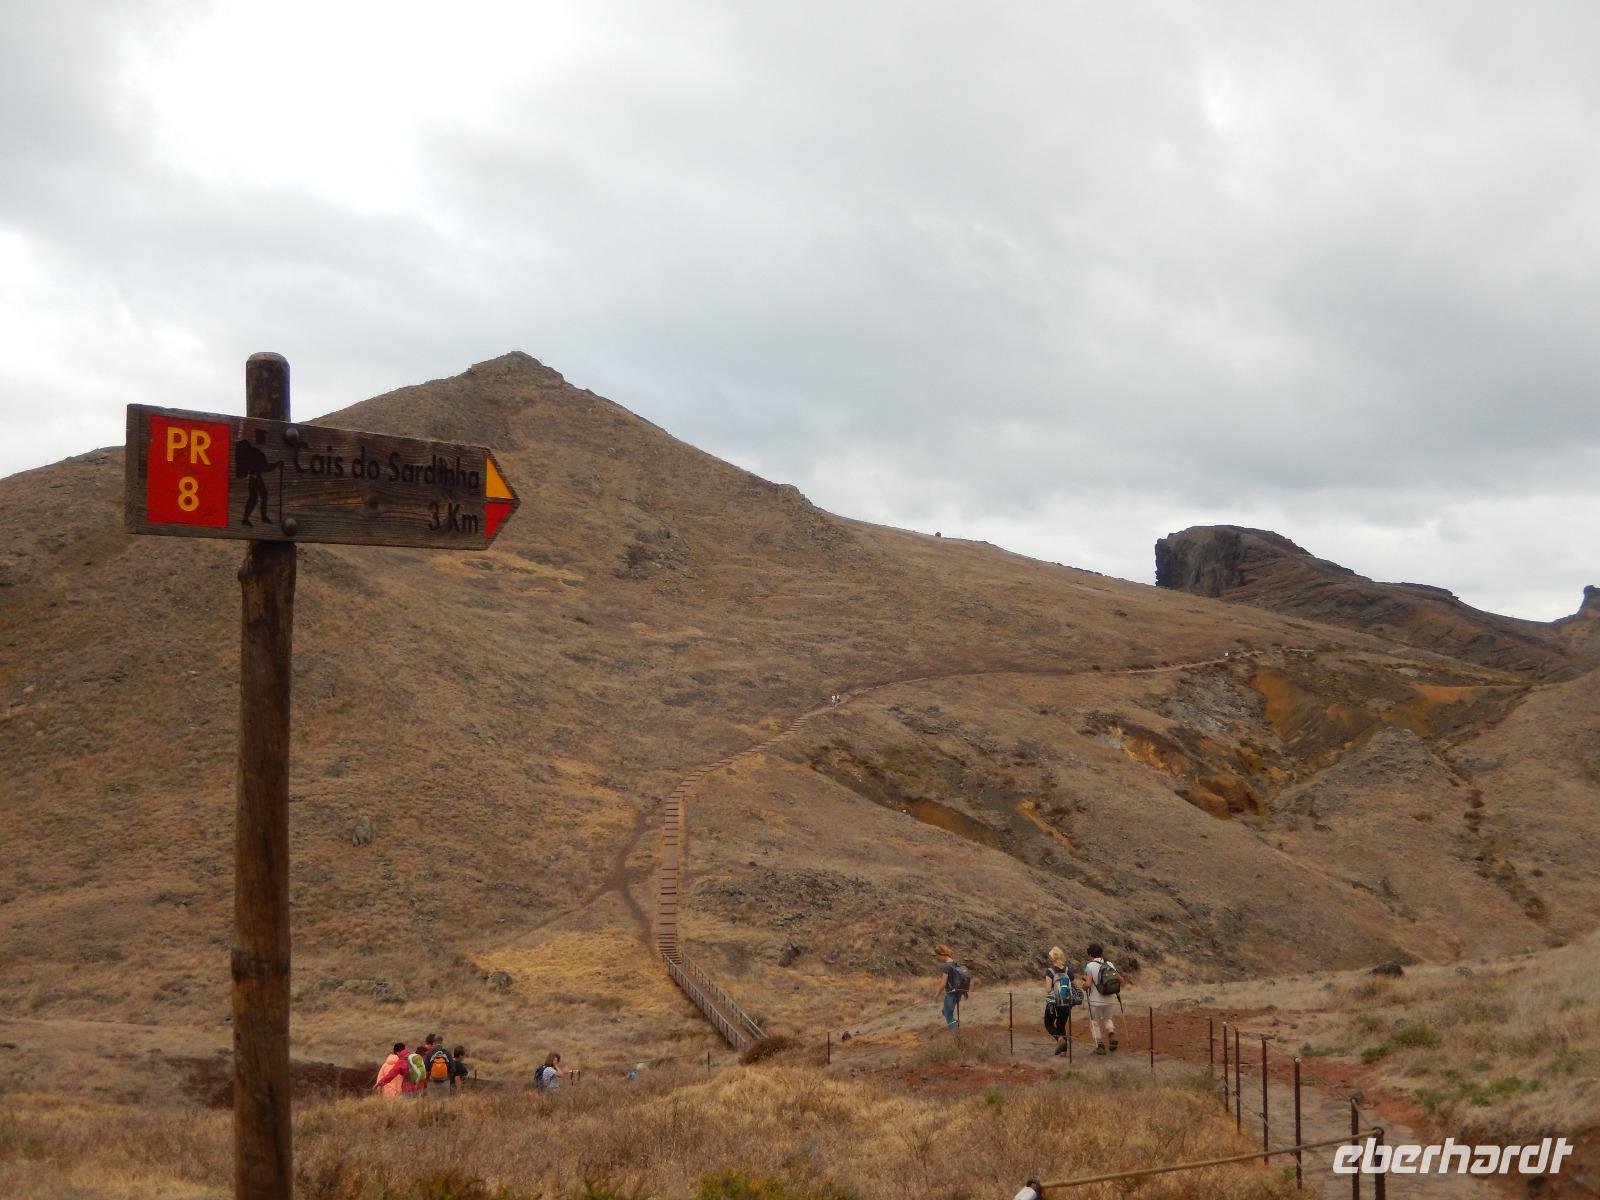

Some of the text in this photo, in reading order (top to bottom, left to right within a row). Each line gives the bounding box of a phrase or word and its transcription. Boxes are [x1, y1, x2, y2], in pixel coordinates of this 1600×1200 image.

[165, 426, 211, 466] PR
[294, 442, 343, 476] Cais
[351, 447, 380, 482] do
[177, 476, 199, 512] 8
[428, 502, 479, 534] 3 Km
